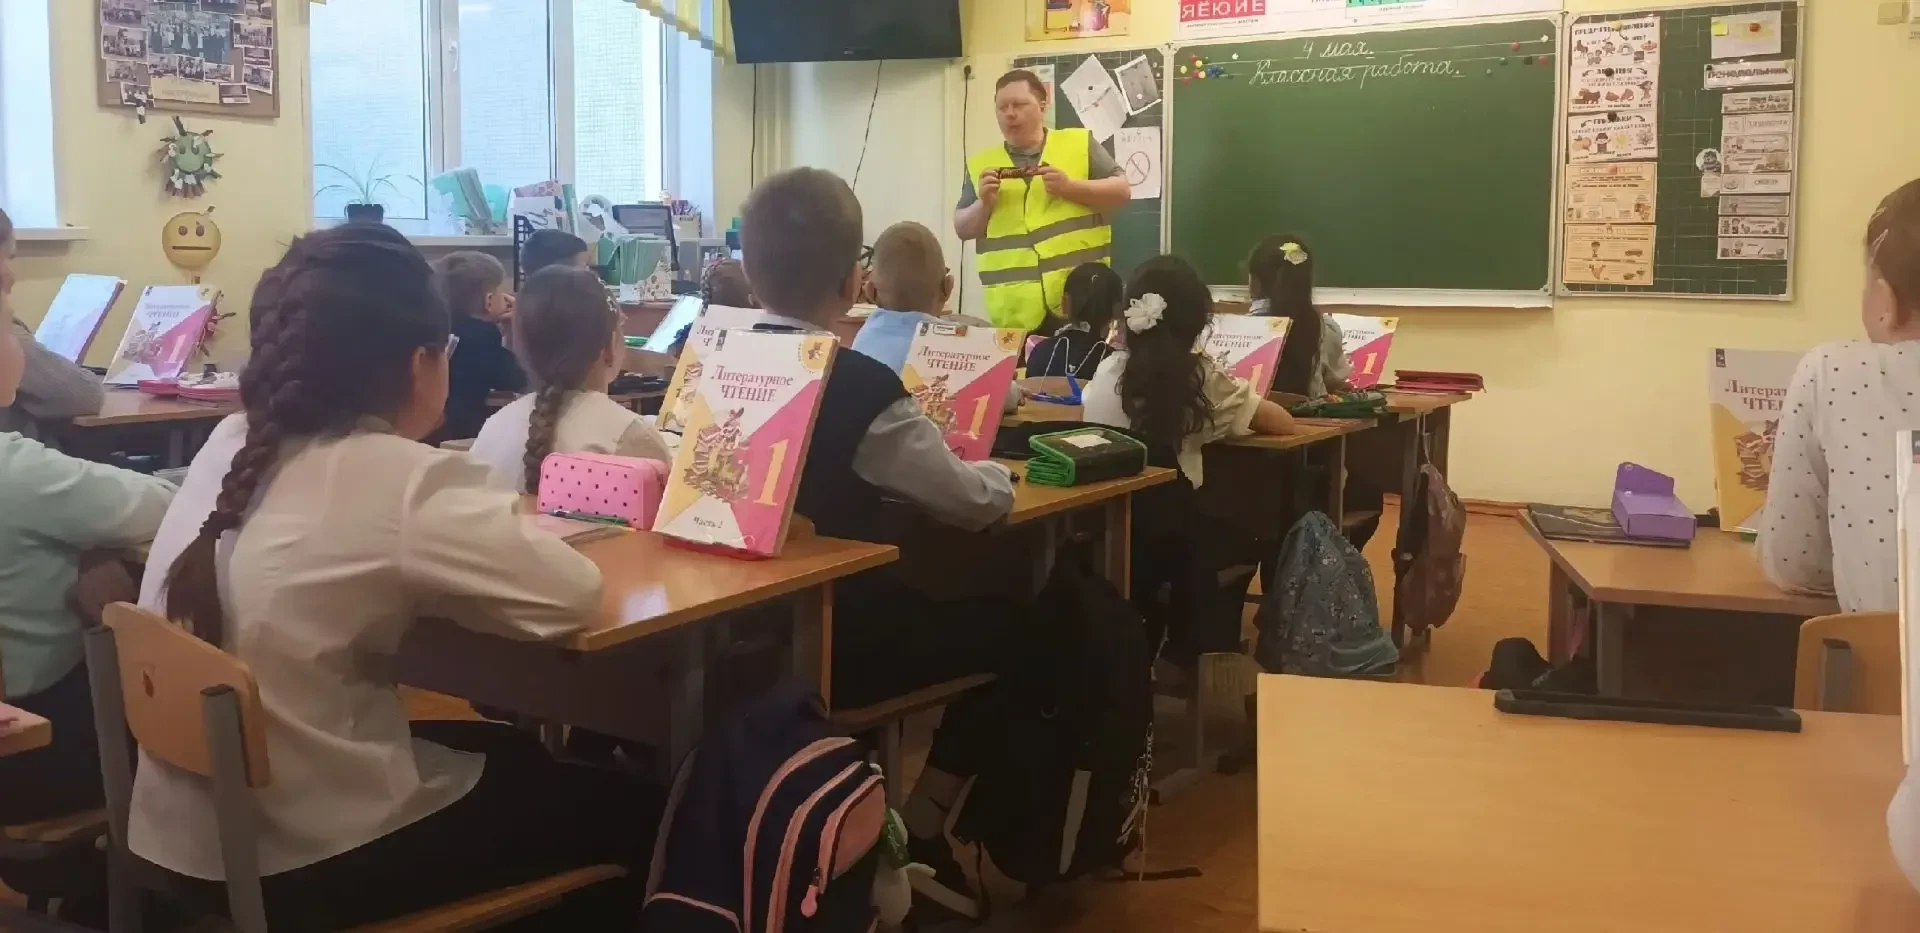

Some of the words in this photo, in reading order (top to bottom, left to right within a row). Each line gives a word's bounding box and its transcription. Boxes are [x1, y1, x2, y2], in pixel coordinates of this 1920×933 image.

[1303, 41, 1314, 59] 4
[1319, 39, 1375, 59] мая.
[1249, 59, 1357, 86] Классная
[1359, 53, 1463, 89] работа.
[163, 334, 188, 364] 1
[710, 364, 794, 388] Литературное
[927, 358, 977, 372] ЧТЕНИЕ
[1360, 351, 1379, 376] 1
[720, 384, 777, 402] ЧТЕНИЕ
[962, 393, 991, 440] 1
[753, 438, 790, 506] 1
